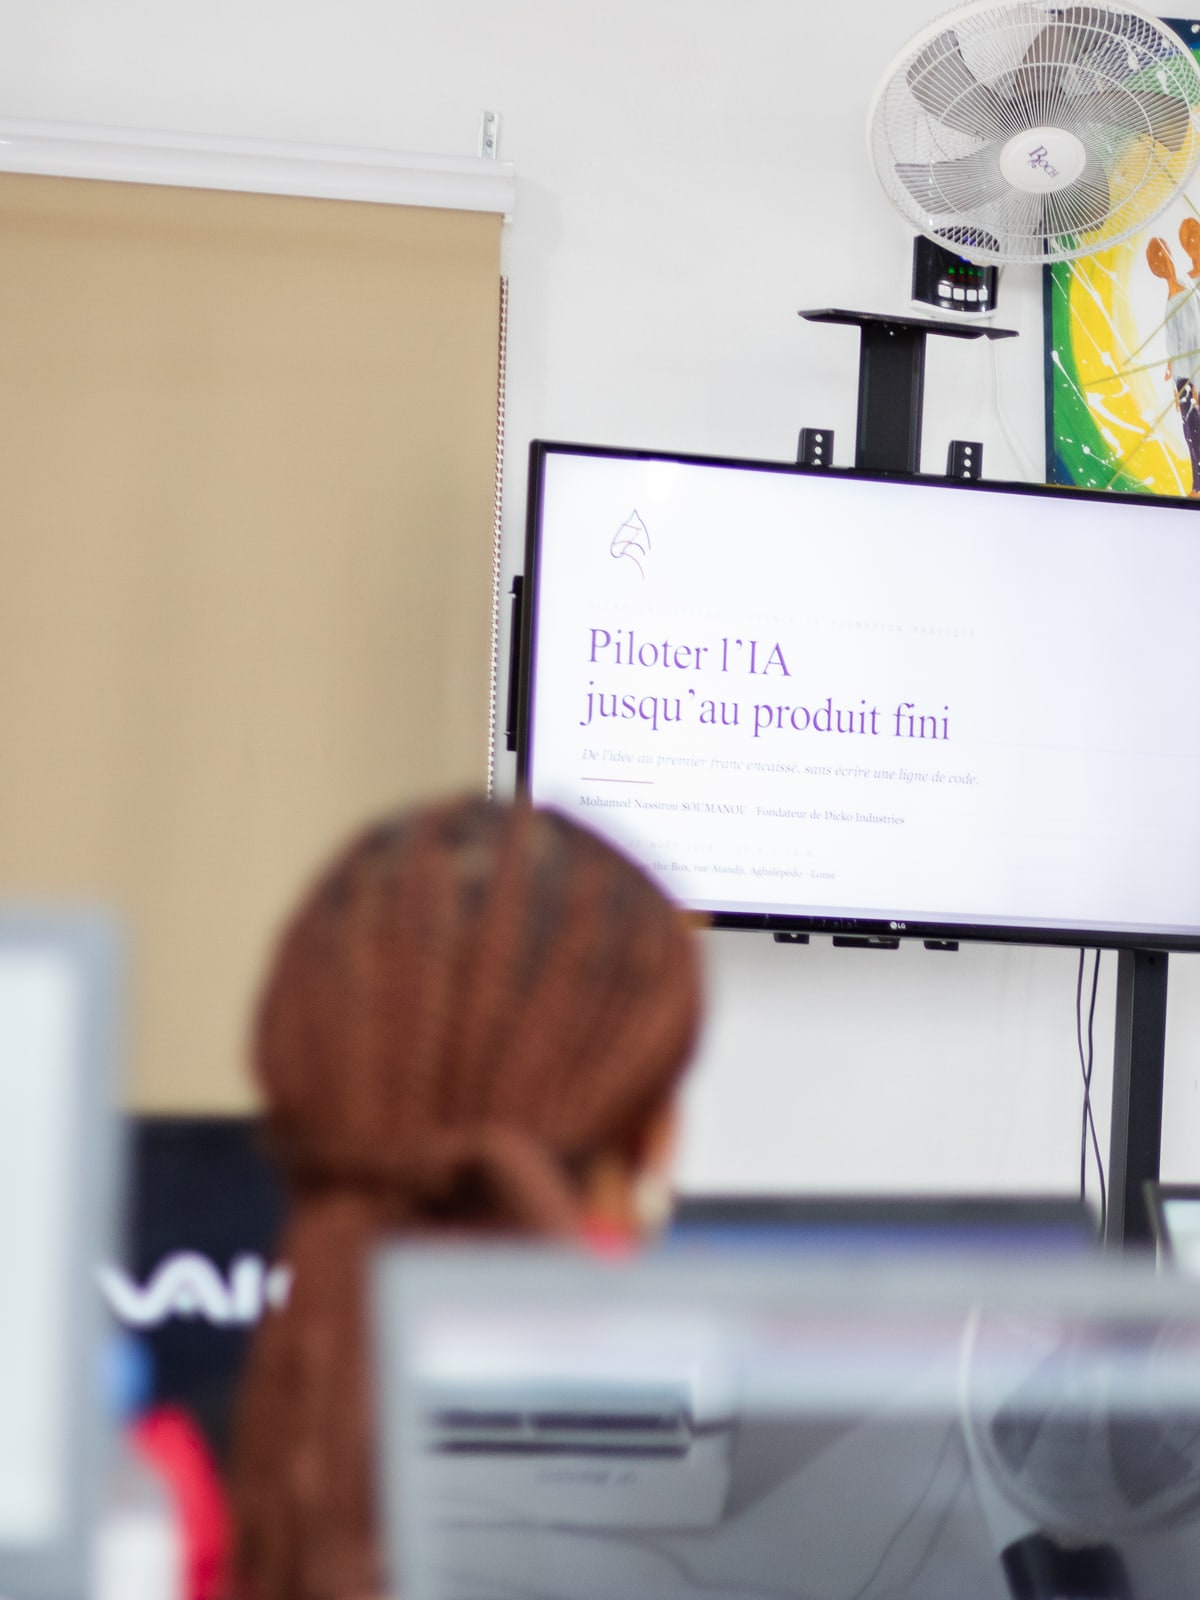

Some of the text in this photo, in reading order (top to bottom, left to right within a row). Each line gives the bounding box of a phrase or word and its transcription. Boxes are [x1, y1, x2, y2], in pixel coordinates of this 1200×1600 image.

[587, 627, 793, 678] Piloter l’IA
[579, 680, 952, 742] jusqu’au produit fini
[582, 748, 600, 762] De
[638, 754, 653, 765] au
[656, 754, 707, 769] premier
[709, 756, 745, 772] franc
[804, 764, 832, 776] sans
[873, 768, 897, 781] une
[898, 767, 930, 785] ligne
[931, 770, 946, 784] de
[948, 771, 980, 786] code.
[580, 794, 631, 809] Mohamed
[681, 801, 749, 815] SOUMANOU
[755, 805, 808, 820] Fondateur
[809, 808, 822, 820] de
[824, 809, 853, 822] Dicko
[855, 811, 906, 826] Industries
